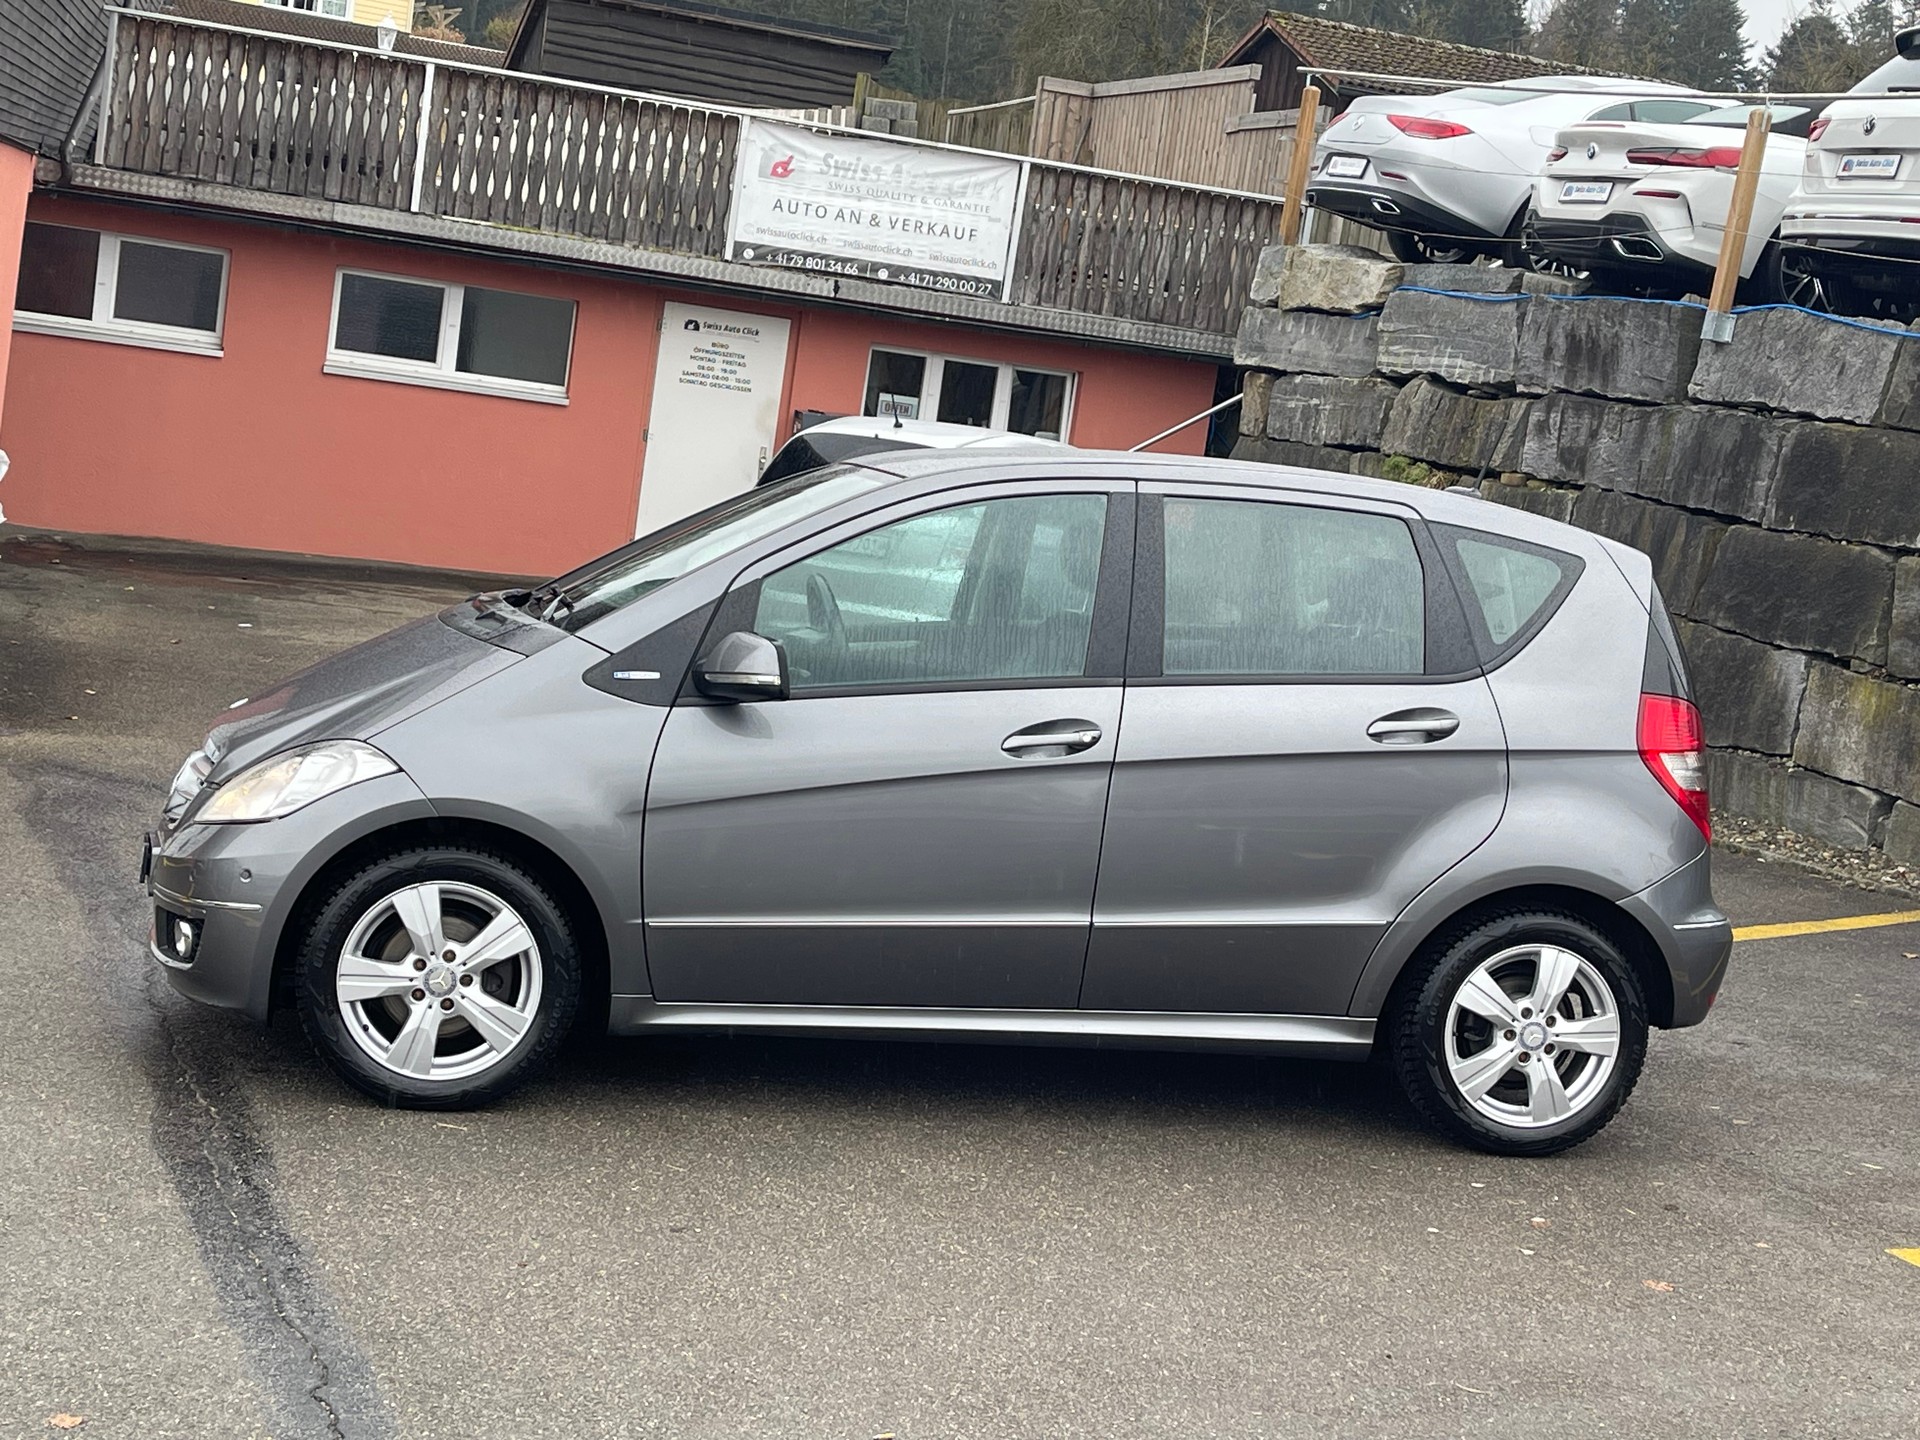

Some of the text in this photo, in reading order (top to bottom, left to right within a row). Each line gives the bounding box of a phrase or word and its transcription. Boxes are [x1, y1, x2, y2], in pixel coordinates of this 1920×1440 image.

[827, 181, 991, 214] SWISS QUALITY & GARANTIE
[772, 198, 978, 242] AUTO AN & VERKAUF
[789, 254, 803, 267] 79
[806, 257, 826, 269] 801
[828, 260, 843, 272] 34
[845, 263, 859, 275] 66
[936, 277, 957, 289] 290
[959, 280, 976, 292] 00
[978, 283, 992, 295] 27
[703, 321, 722, 332] Swiss
[723, 324, 741, 334] Auto
[742, 327, 760, 336] Click
